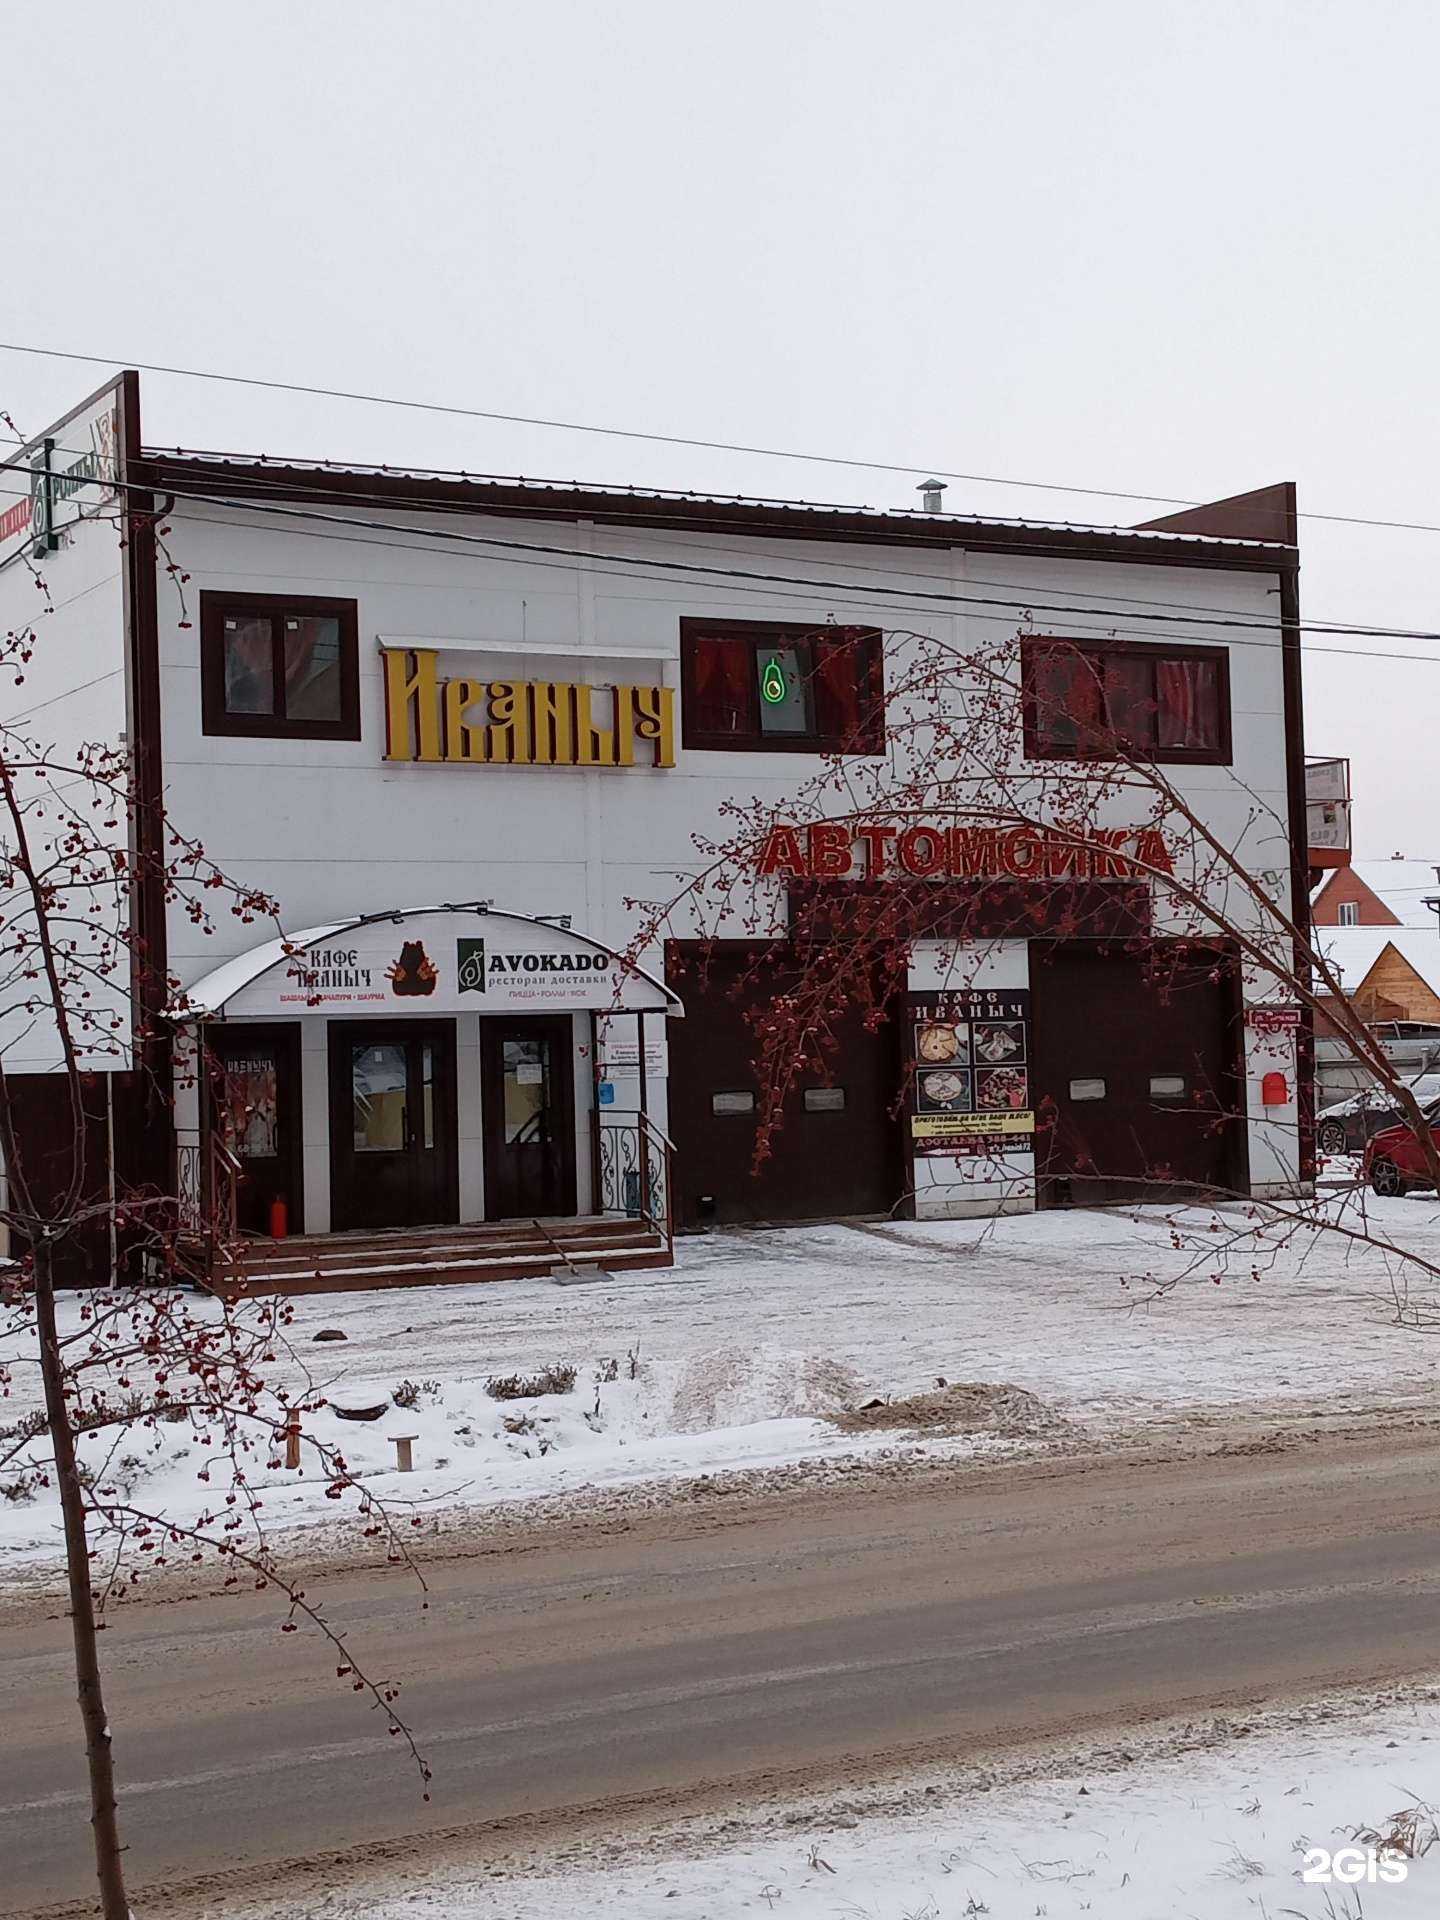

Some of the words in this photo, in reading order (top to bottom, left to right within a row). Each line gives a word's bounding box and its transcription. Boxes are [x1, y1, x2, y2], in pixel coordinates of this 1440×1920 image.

[757, 818, 1175, 879] АВТОМОЙКА
[310, 949, 359, 967] КАФЕ
[488, 953, 609, 972] AVOKADO
[488, 976, 546, 987] ресторан
[551, 975, 607, 985] доставки
[317, 993, 351, 1001] АЧАПУРИ
[915, 1004, 1023, 1019] ИВАНЫЧ
